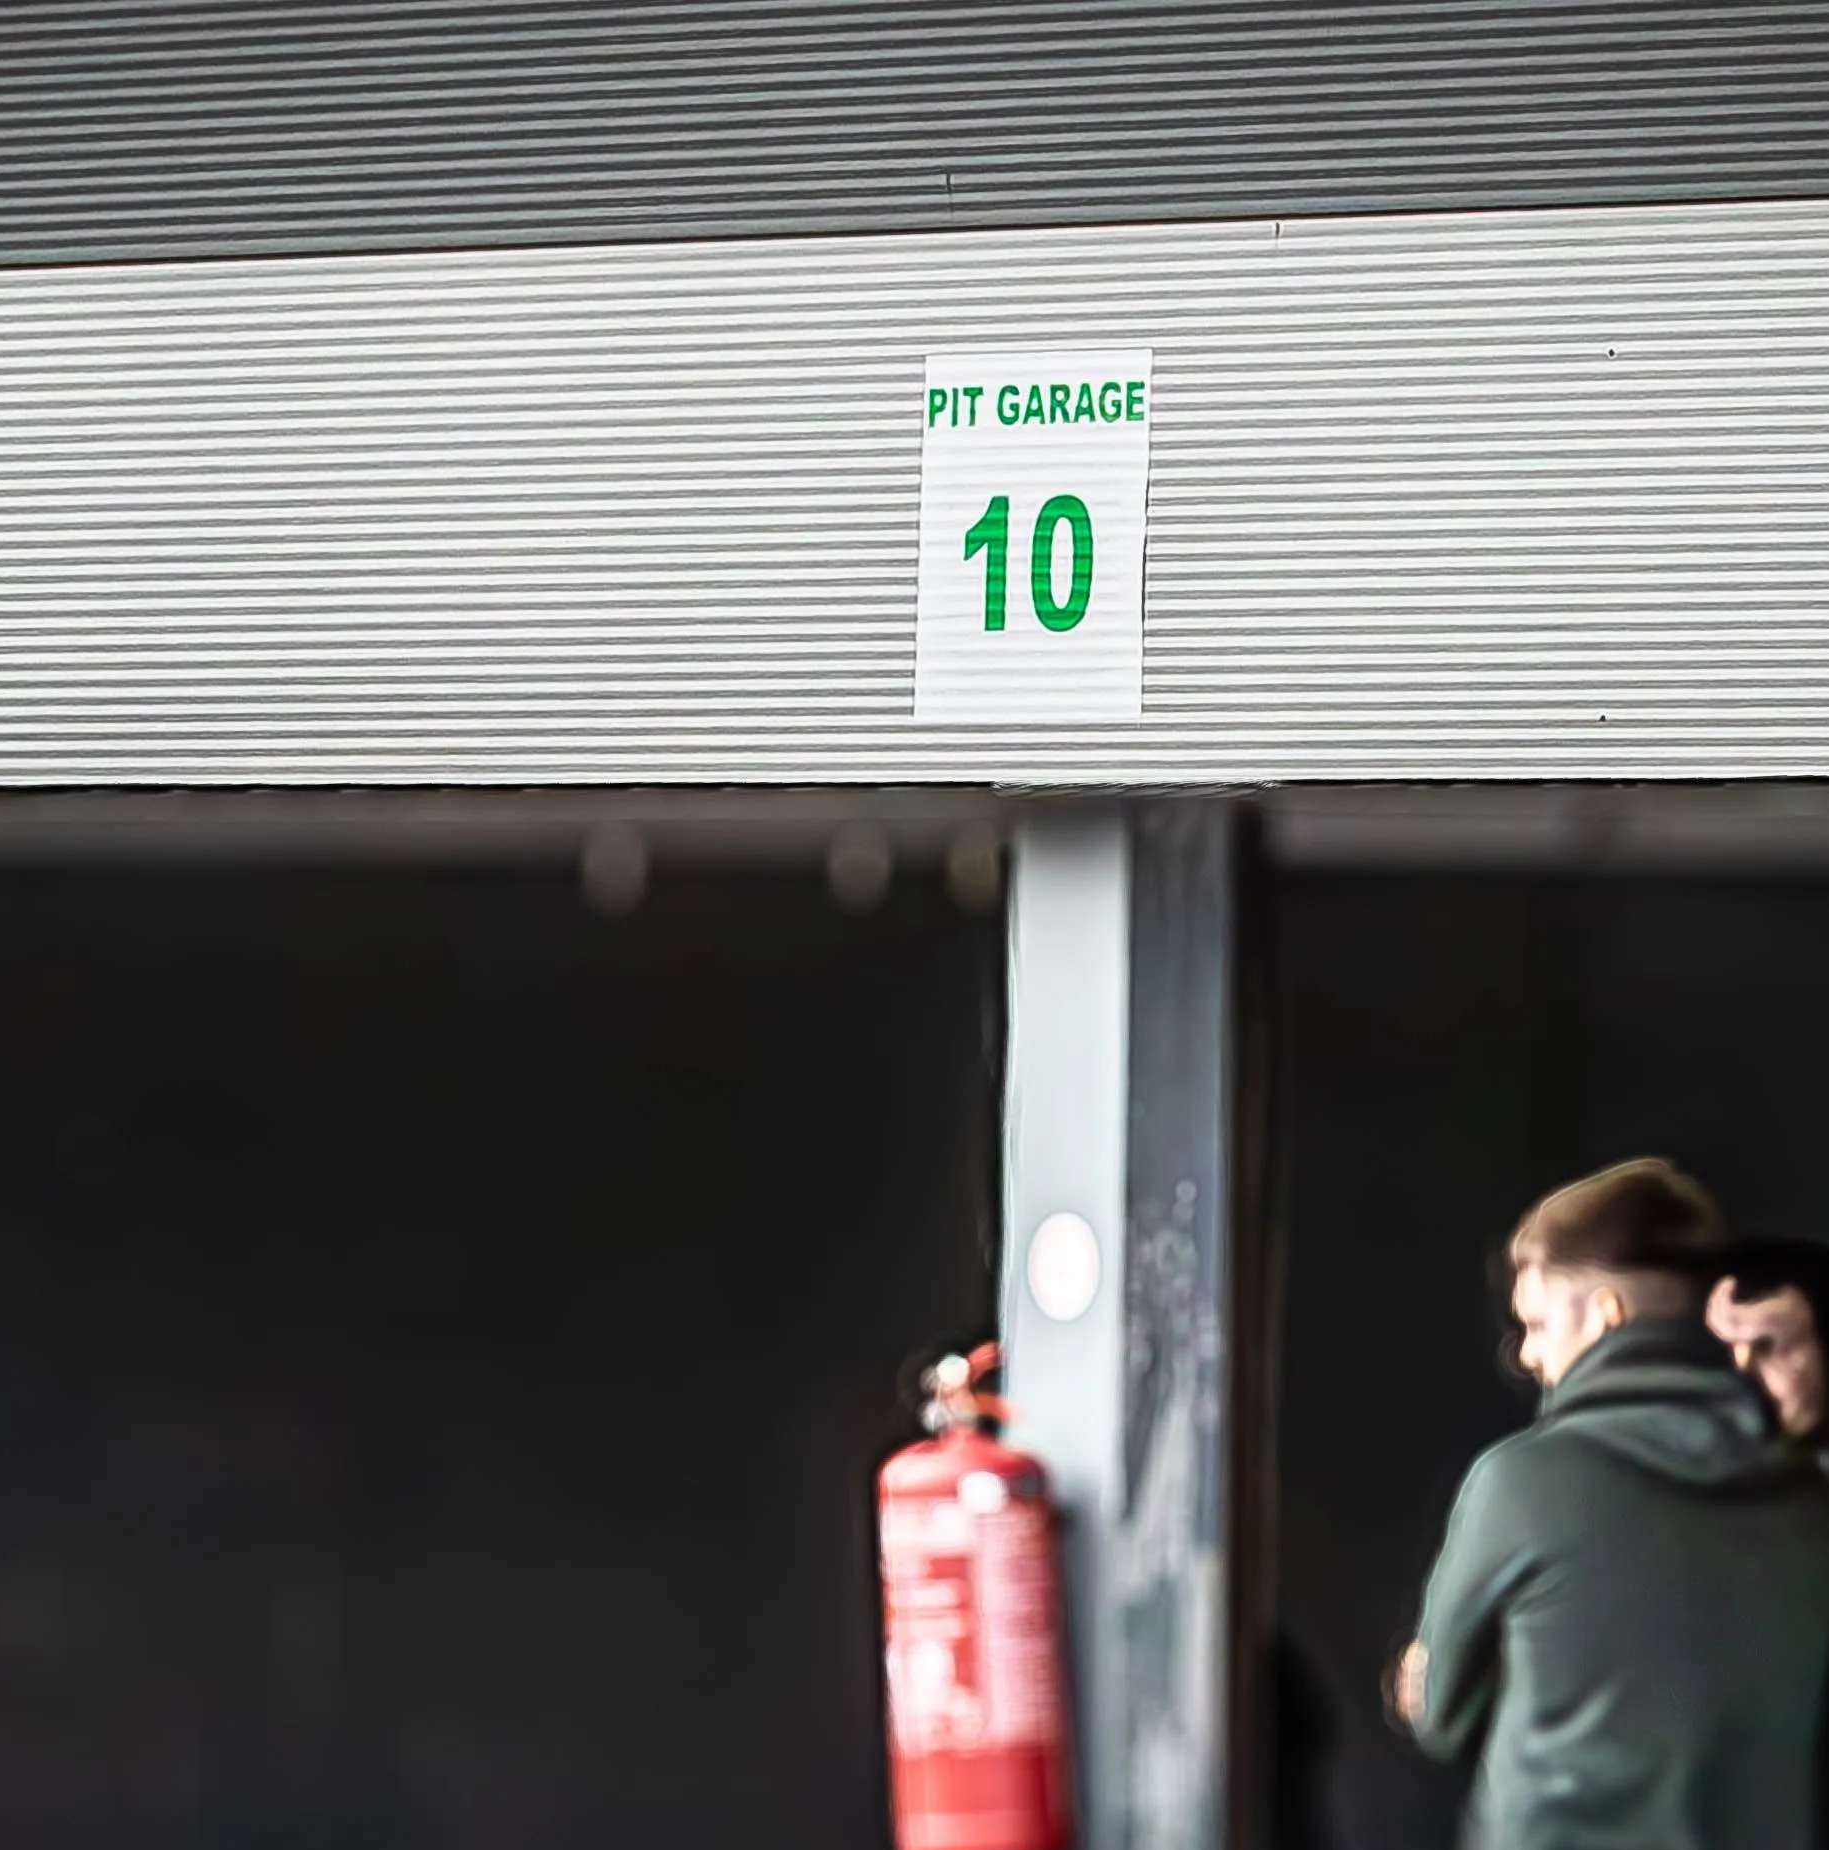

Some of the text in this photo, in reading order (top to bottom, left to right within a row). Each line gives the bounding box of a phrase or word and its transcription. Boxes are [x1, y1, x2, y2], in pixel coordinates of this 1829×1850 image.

[928, 381, 1145, 428] PIT GARAGE
[962, 494, 1094, 632] 10
